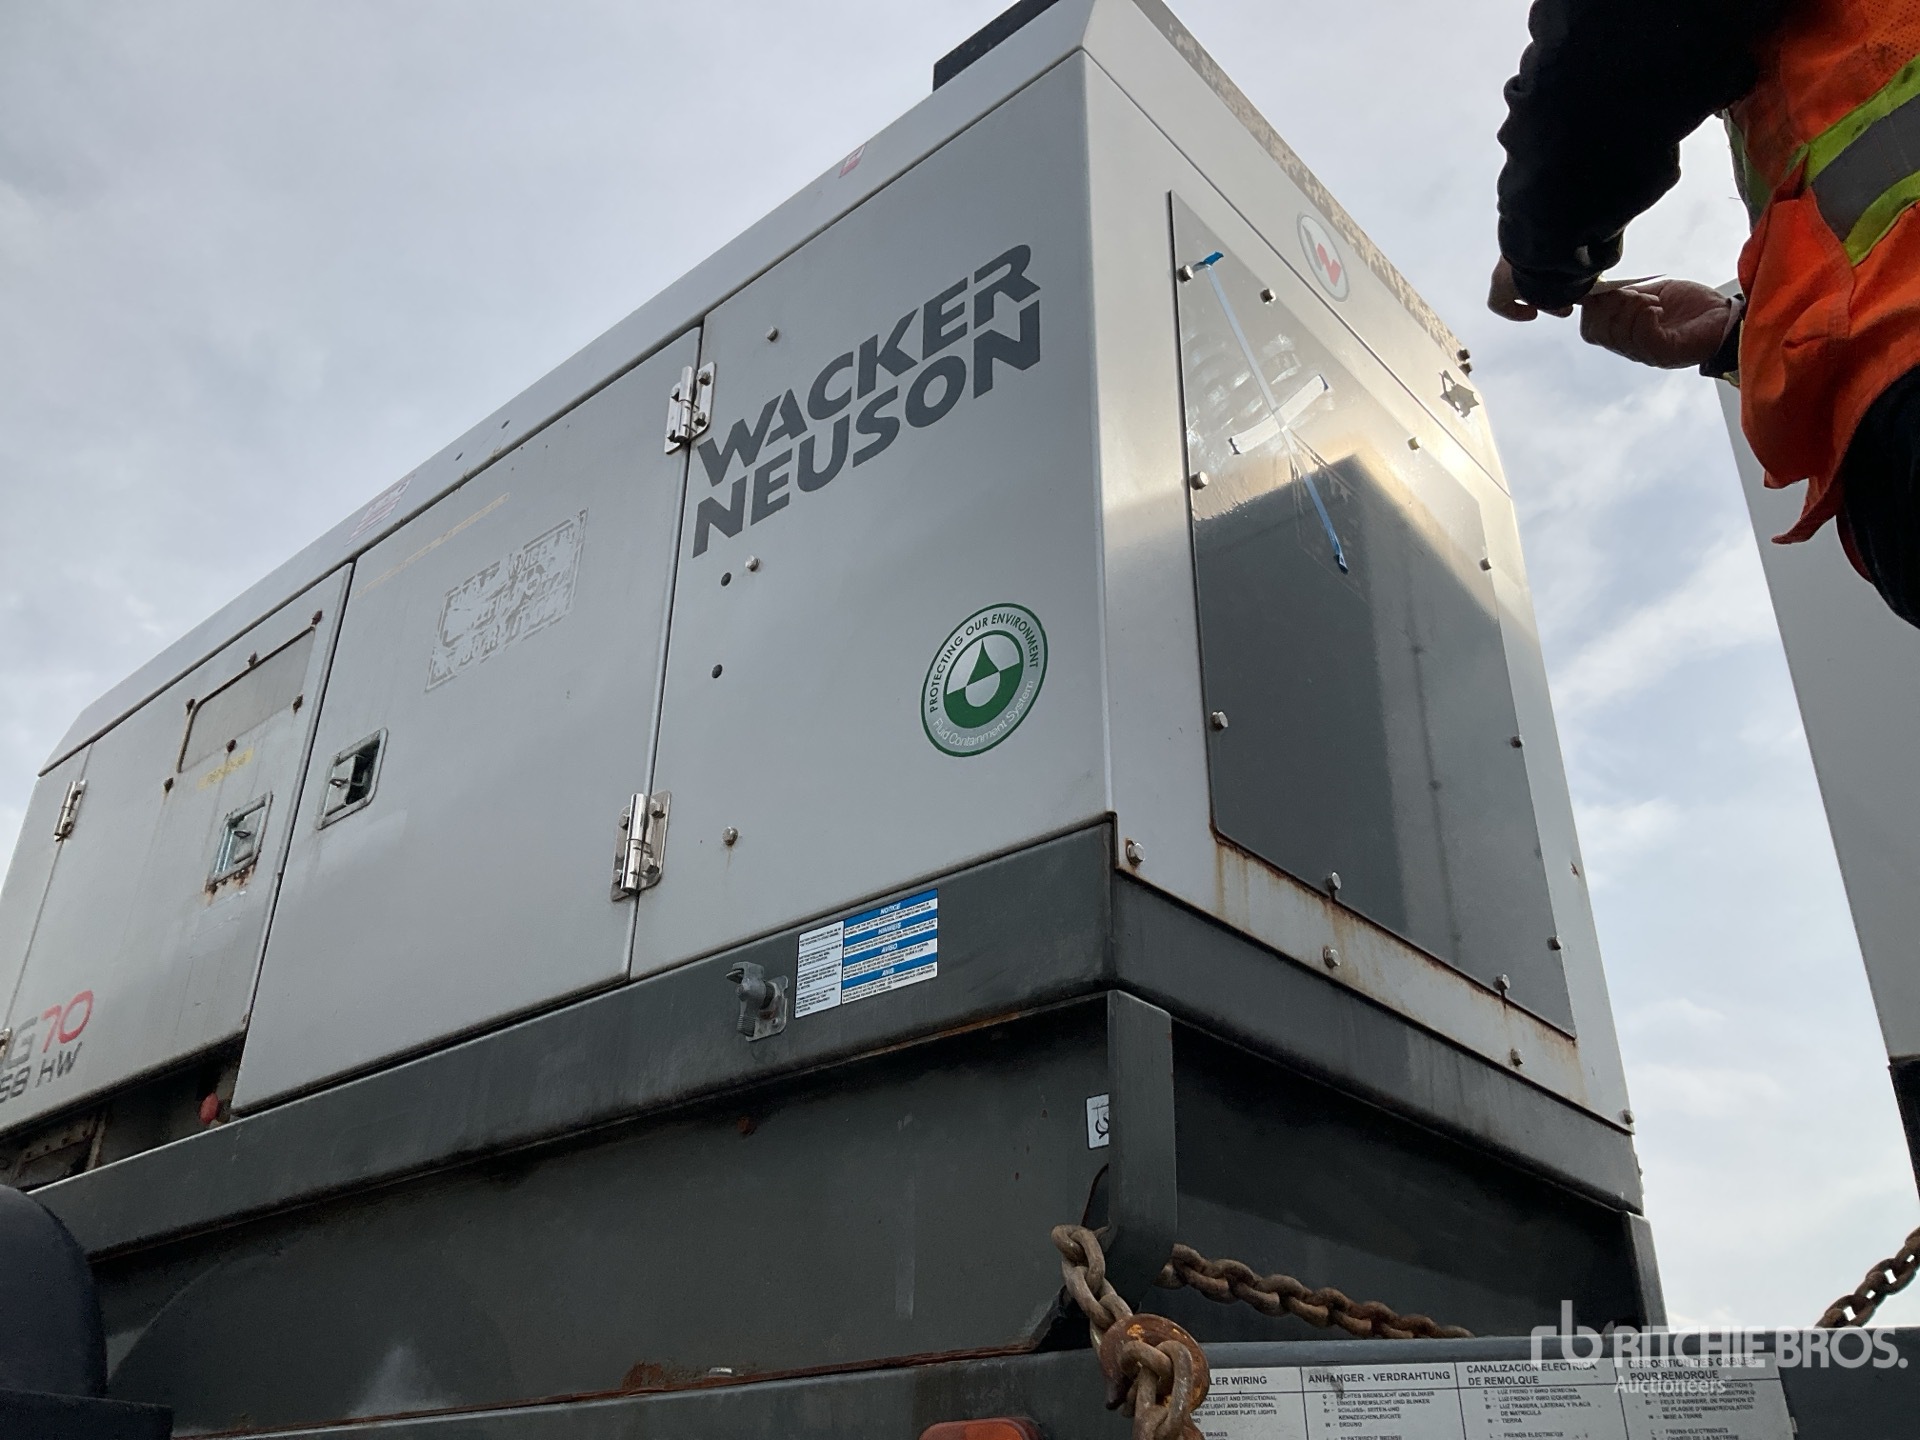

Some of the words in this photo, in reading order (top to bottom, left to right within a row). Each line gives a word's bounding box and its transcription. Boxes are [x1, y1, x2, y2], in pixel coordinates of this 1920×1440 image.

[697, 244, 1041, 487] WACKER
[692, 299, 1041, 559] NEUSON
[930, 636, 964, 713] PROTECTING
[965, 617, 988, 636] OUR
[991, 613, 1039, 668] ENVIRONMENT
[933, 717, 951, 740] Fluid
[949, 720, 1007, 747] Containment
[1006, 681, 1034, 722] System
[1466, 1363, 1539, 1373] CANALIZACION
[1541, 1362, 1597, 1371] ELECTRICA
[1209, 1376, 1229, 1385] LER
[1231, 1375, 1267, 1385] WIRING
[1373, 1371, 1451, 1381] VERDRAHTUNG
[1468, 1377, 1481, 1385] DE
[1484, 1375, 1540, 1385] REMOLQUE
[1630, 1371, 1660, 1381] POUR
[1660, 1370, 1719, 1380] REMORQUE
